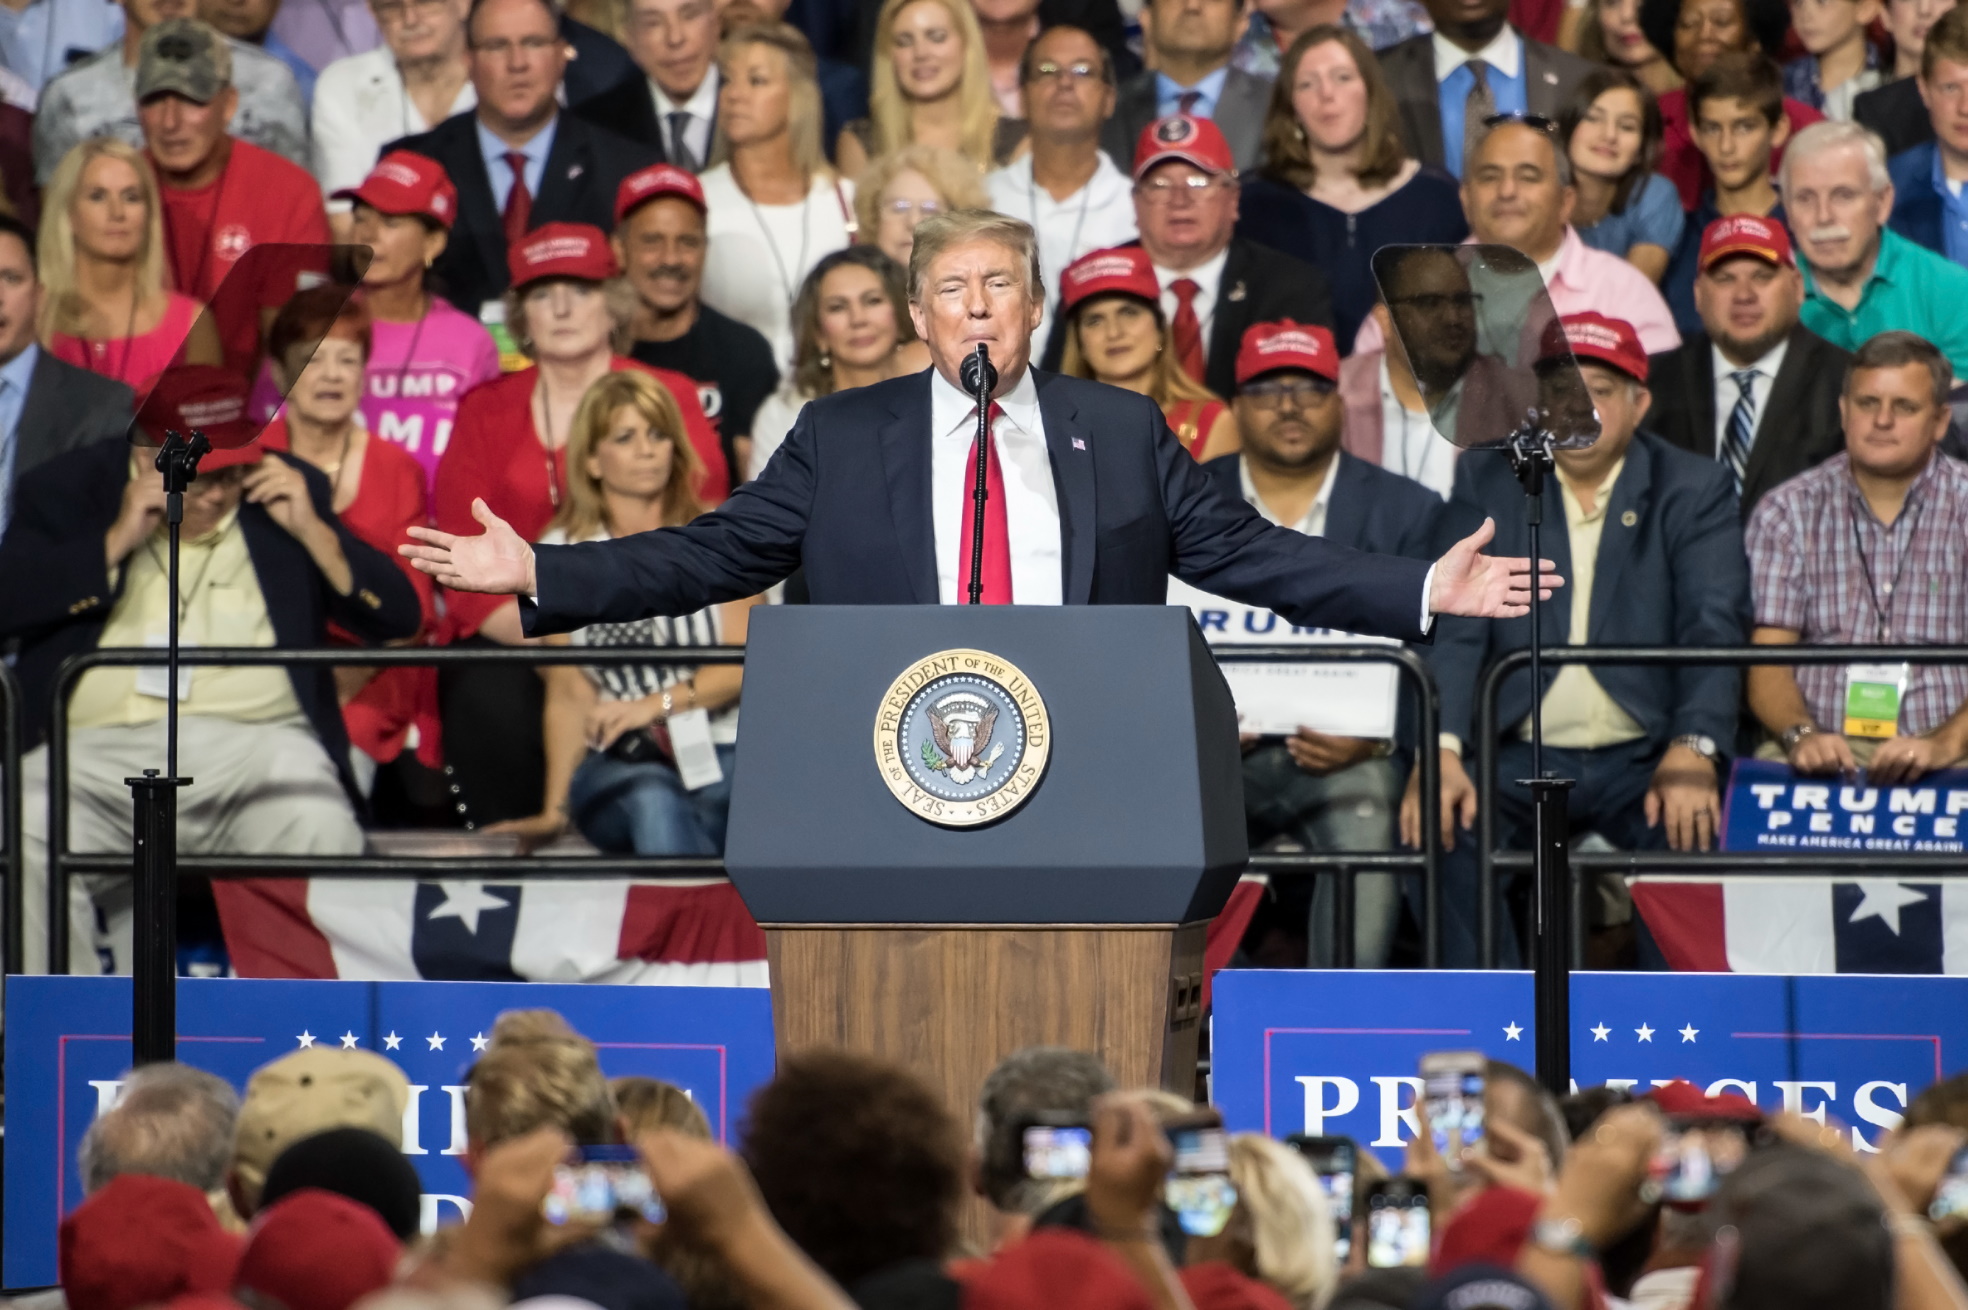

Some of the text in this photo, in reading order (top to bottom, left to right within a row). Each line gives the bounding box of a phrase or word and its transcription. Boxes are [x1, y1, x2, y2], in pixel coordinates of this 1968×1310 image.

[370, 373, 457, 398] UMP
[881, 656, 1044, 817] SEAL OF THE PRESIDENT OF THE UNITED STATES
[1767, 811, 1958, 837] PENCE
[1757, 834, 1964, 854] MAKE AMERICA GREAT AGAIN!
